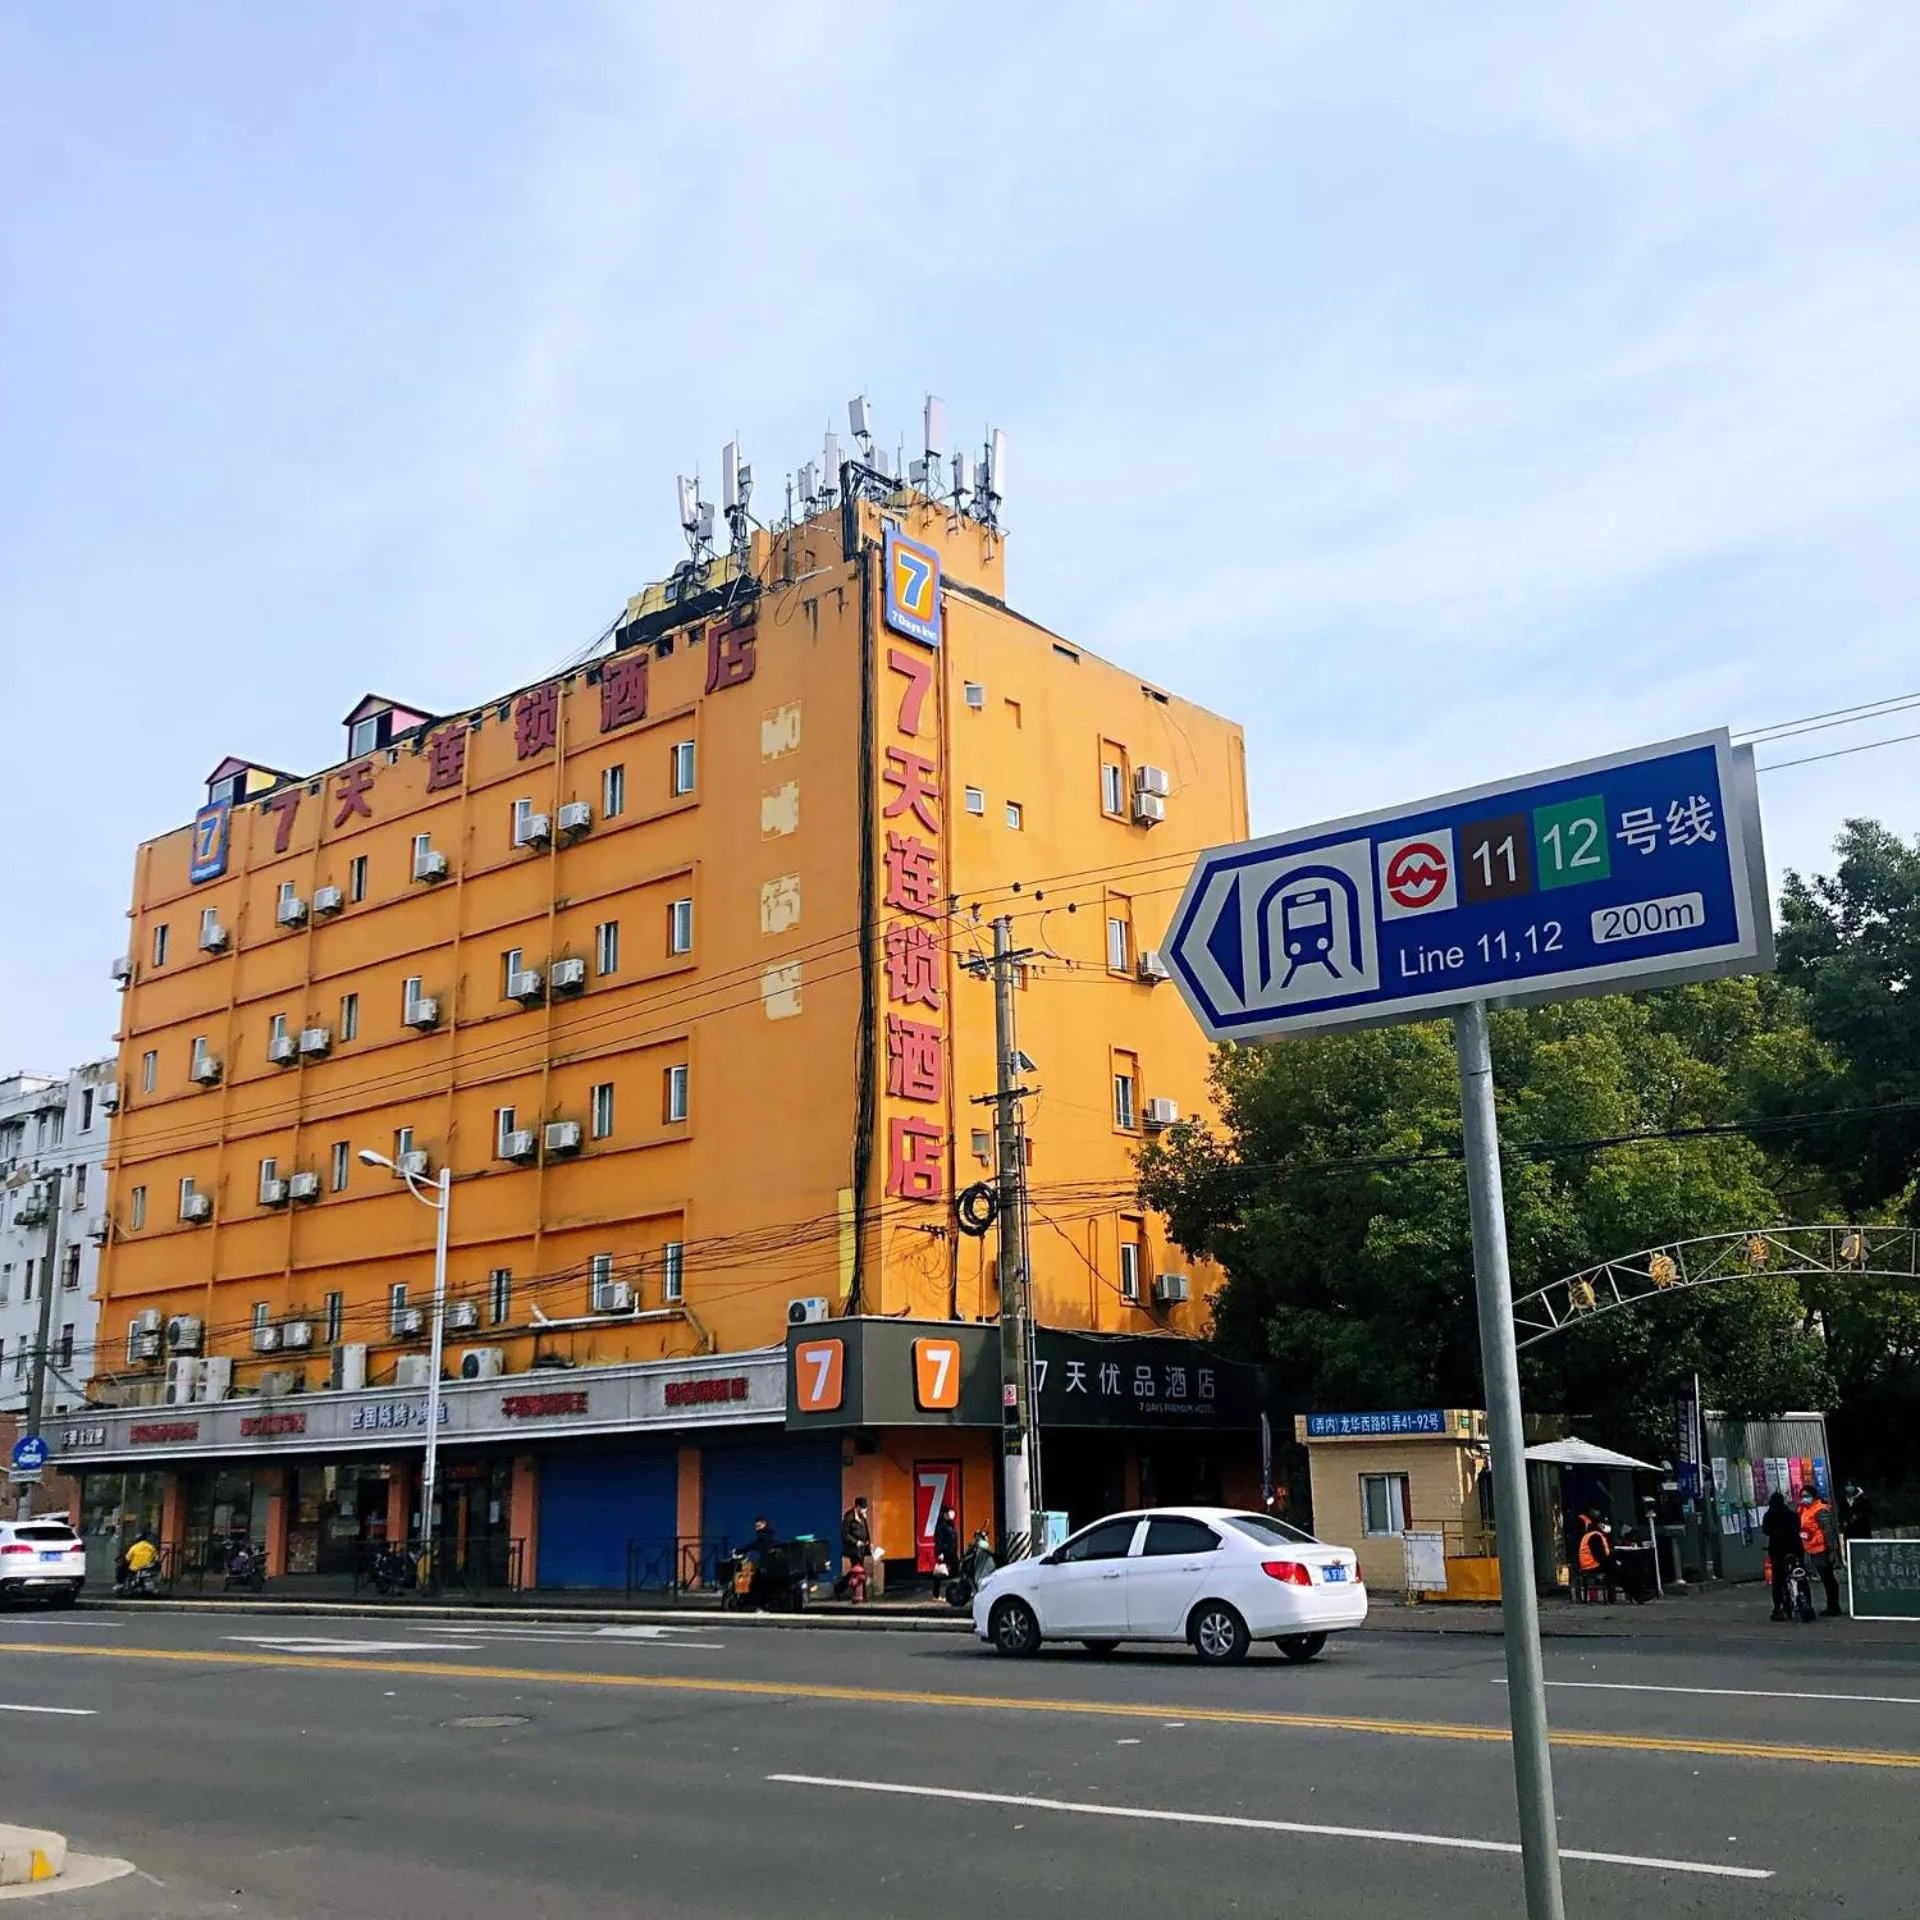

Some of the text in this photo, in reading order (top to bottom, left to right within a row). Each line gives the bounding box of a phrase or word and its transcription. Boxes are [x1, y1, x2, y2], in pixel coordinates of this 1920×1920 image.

[899, 550, 930, 609] 7
[899, 613, 921, 633] Days
[922, 625, 937, 639] Inn
[271, 617, 757, 854] 7天连锁酒店
[200, 814, 220, 858] 7
[1472, 794, 1718, 887] 11 12 号线
[883, 648, 944, 1203] 7天连锁酒店
[1400, 902, 1695, 977] Line 11,12 200m
[805, 1349, 833, 1402] 7
[926, 1349, 952, 1400] 7
[1034, 1359, 1216, 1399] 7天优品酒店
[918, 1473, 949, 1537] 7
